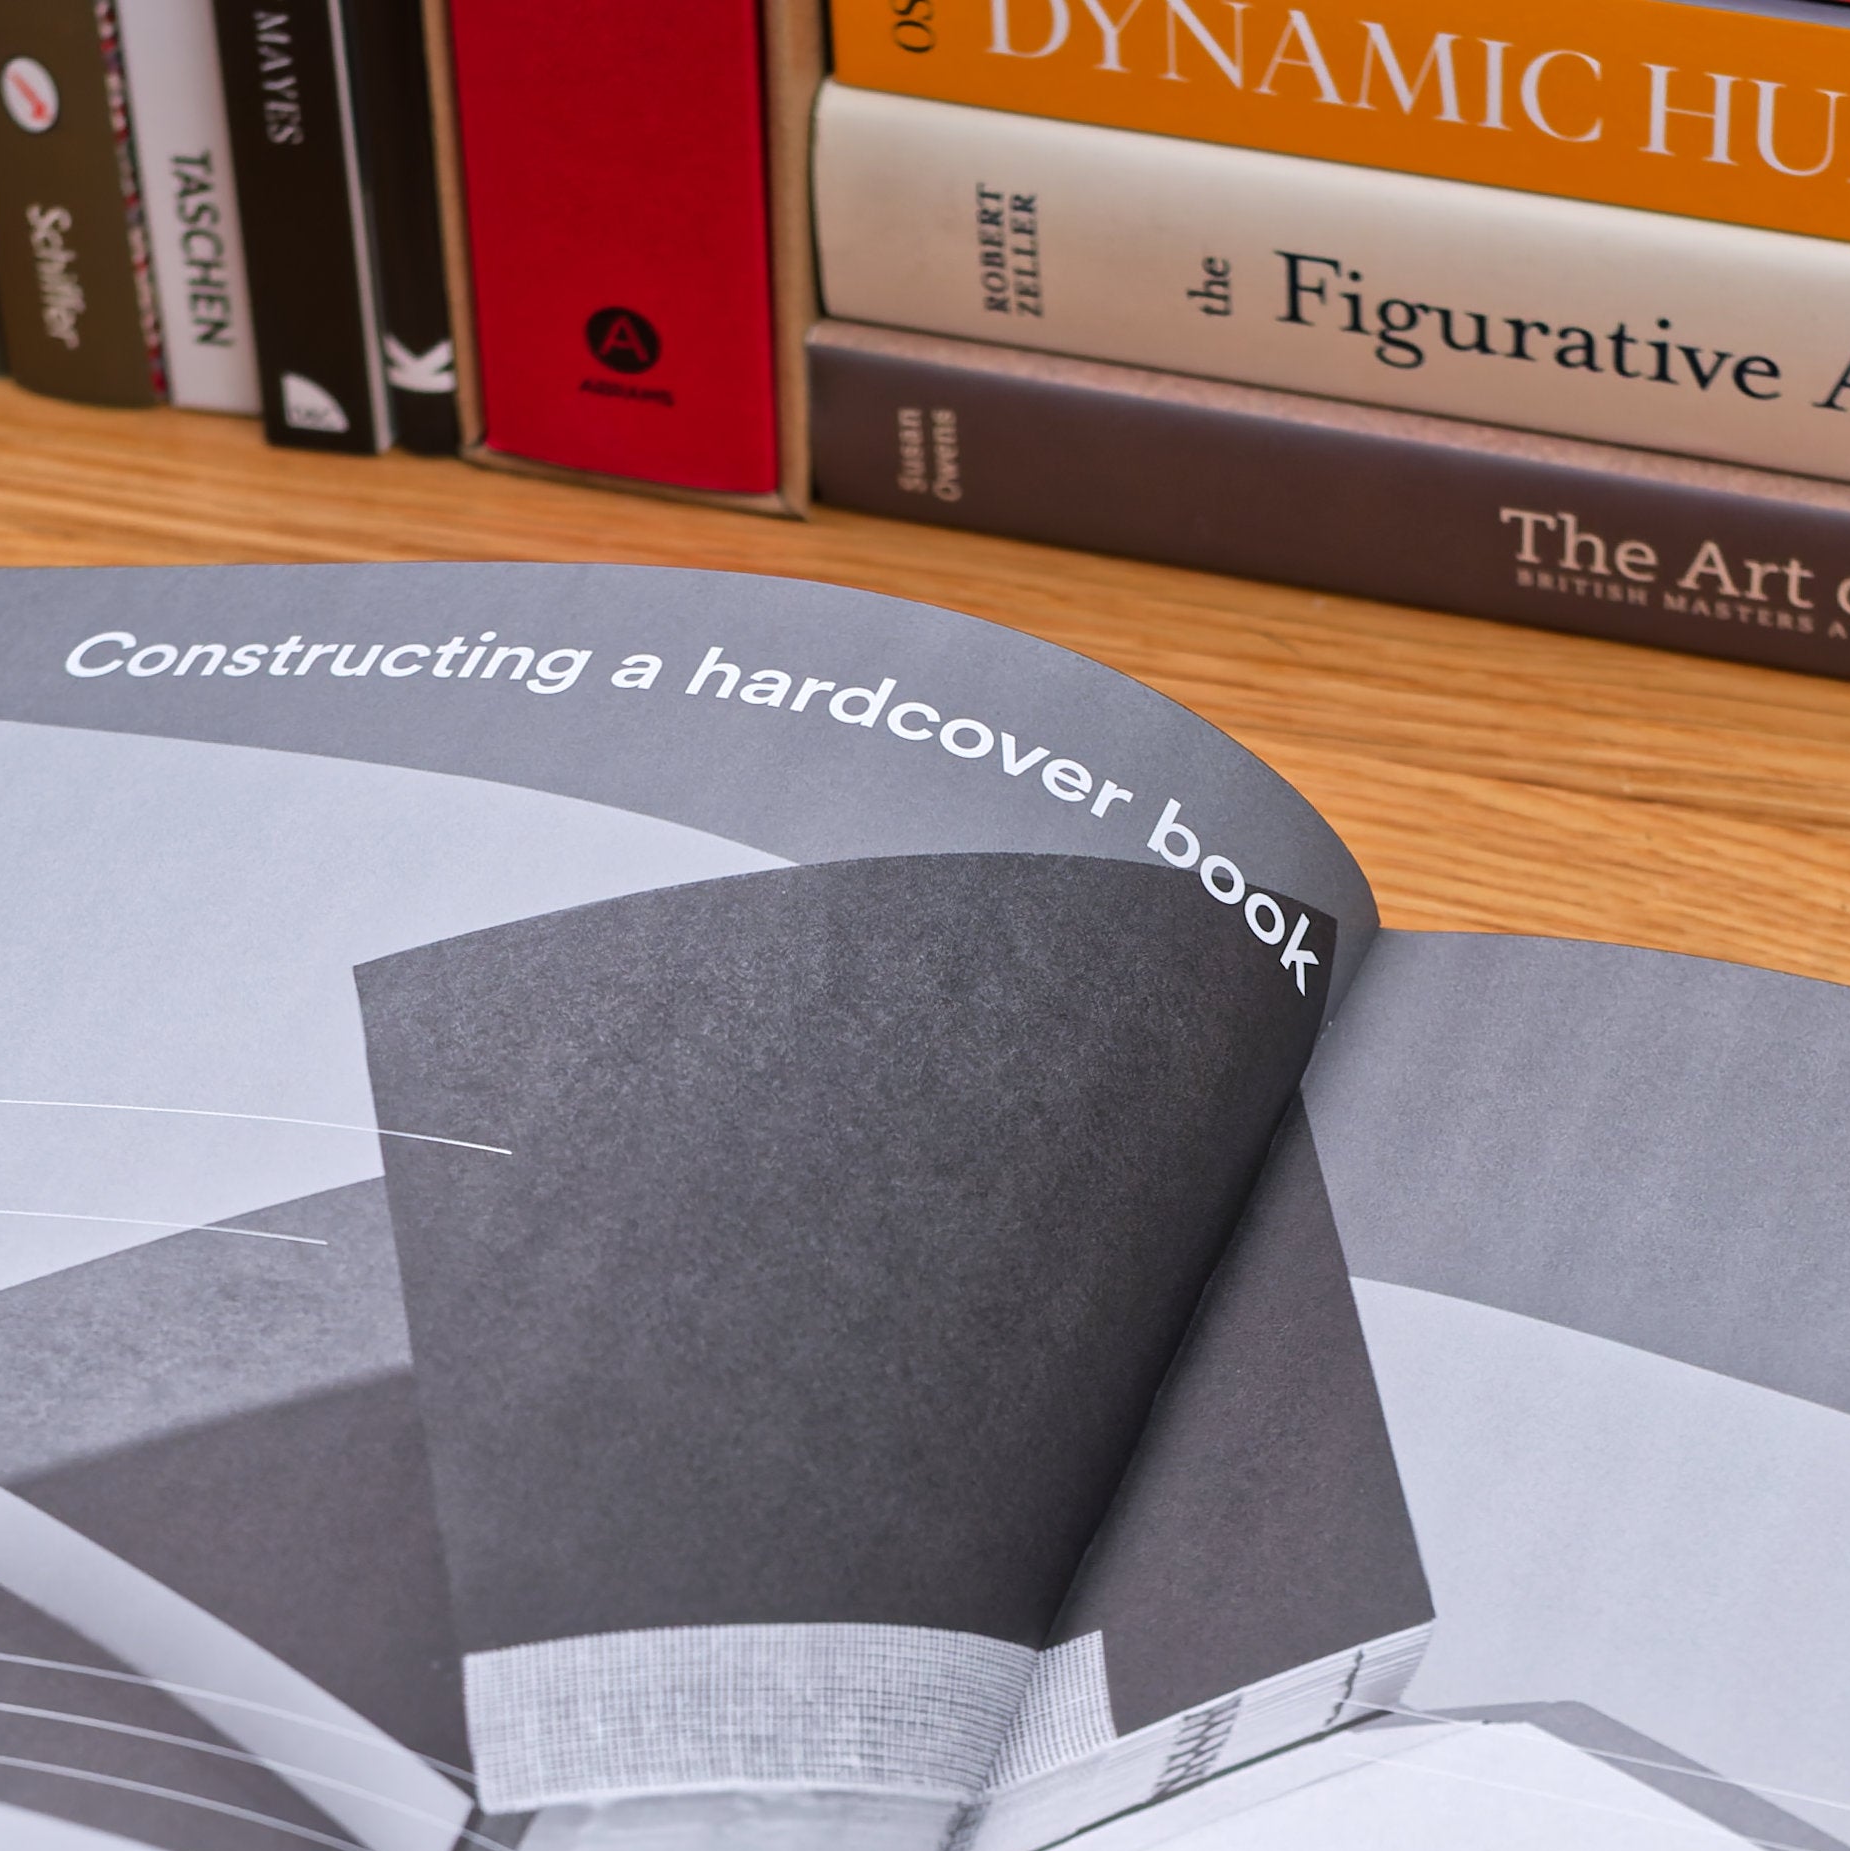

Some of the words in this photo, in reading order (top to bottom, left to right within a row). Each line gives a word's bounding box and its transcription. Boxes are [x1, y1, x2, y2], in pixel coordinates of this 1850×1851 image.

[254, 10, 305, 146] MAYES
[987, 0, 1603, 143] DYNAMIC
[26, 204, 86, 349] Schiffer
[172, 151, 236, 348] TASCHEN
[975, 183, 1010, 315] ROBERT
[1011, 193, 1044, 319] ZELLER
[383, 334, 457, 394] K
[1187, 256, 1232, 316] the
[1273, 249, 1782, 402] Figurative
[898, 409, 922, 491] Susan
[934, 408, 962, 502] Owens
[1500, 506, 1659, 582] The
[1676, 540, 1814, 607] Art
[1515, 567, 1650, 606] BRITISH
[1663, 589, 1816, 634] MASTERS
[65, 630, 592, 696] Constructing
[611, 649, 663, 692] a
[685, 646, 1134, 818] hardcover
[1147, 797, 1320, 997] book
